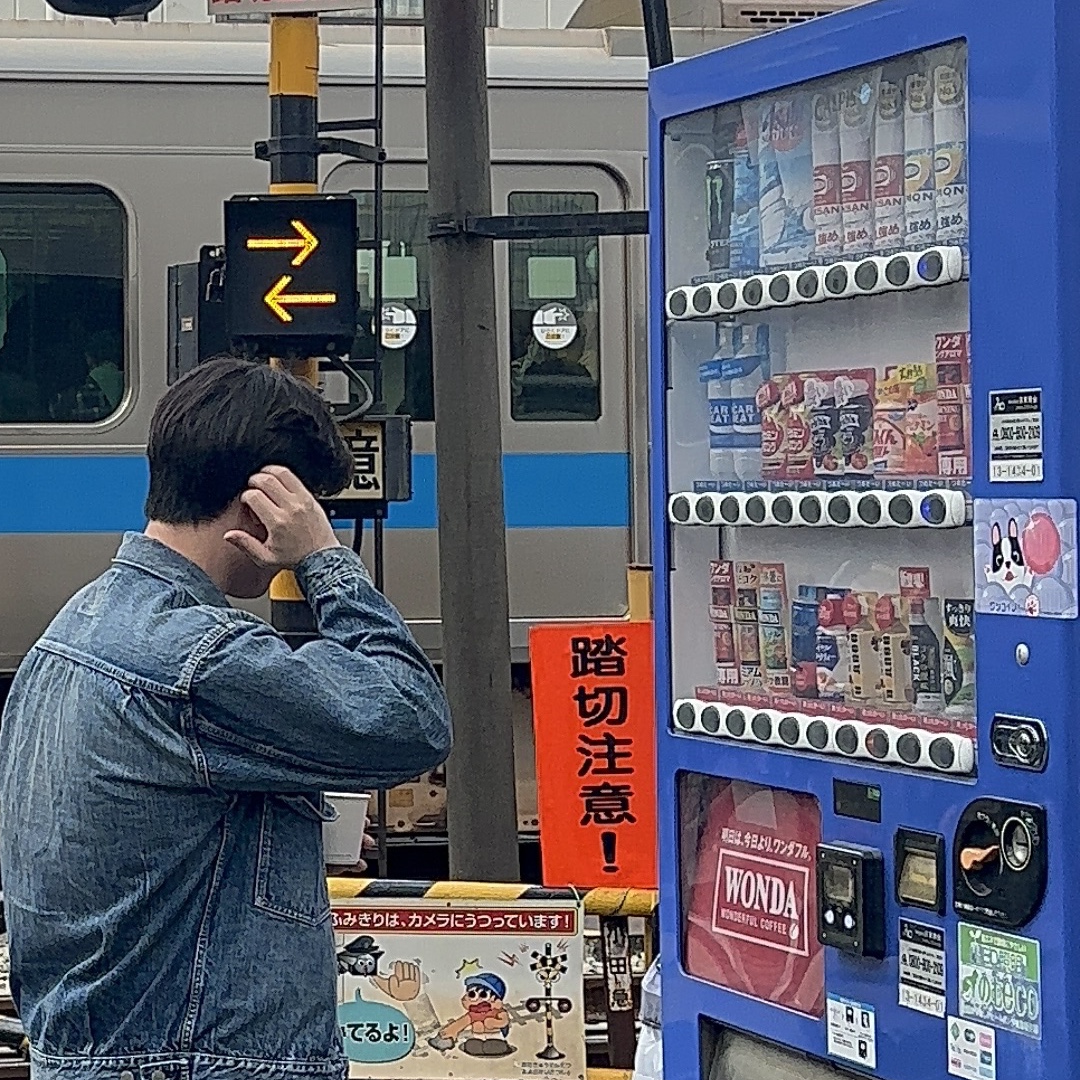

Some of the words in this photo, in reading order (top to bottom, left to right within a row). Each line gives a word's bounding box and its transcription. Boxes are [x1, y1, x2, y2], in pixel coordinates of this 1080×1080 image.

[570, 633, 637, 874] 踏切注意!
[724, 865, 799, 920] WONDA
[720, 907, 758, 928] WONDERFUL
[760, 918, 788, 935] COFFEE
